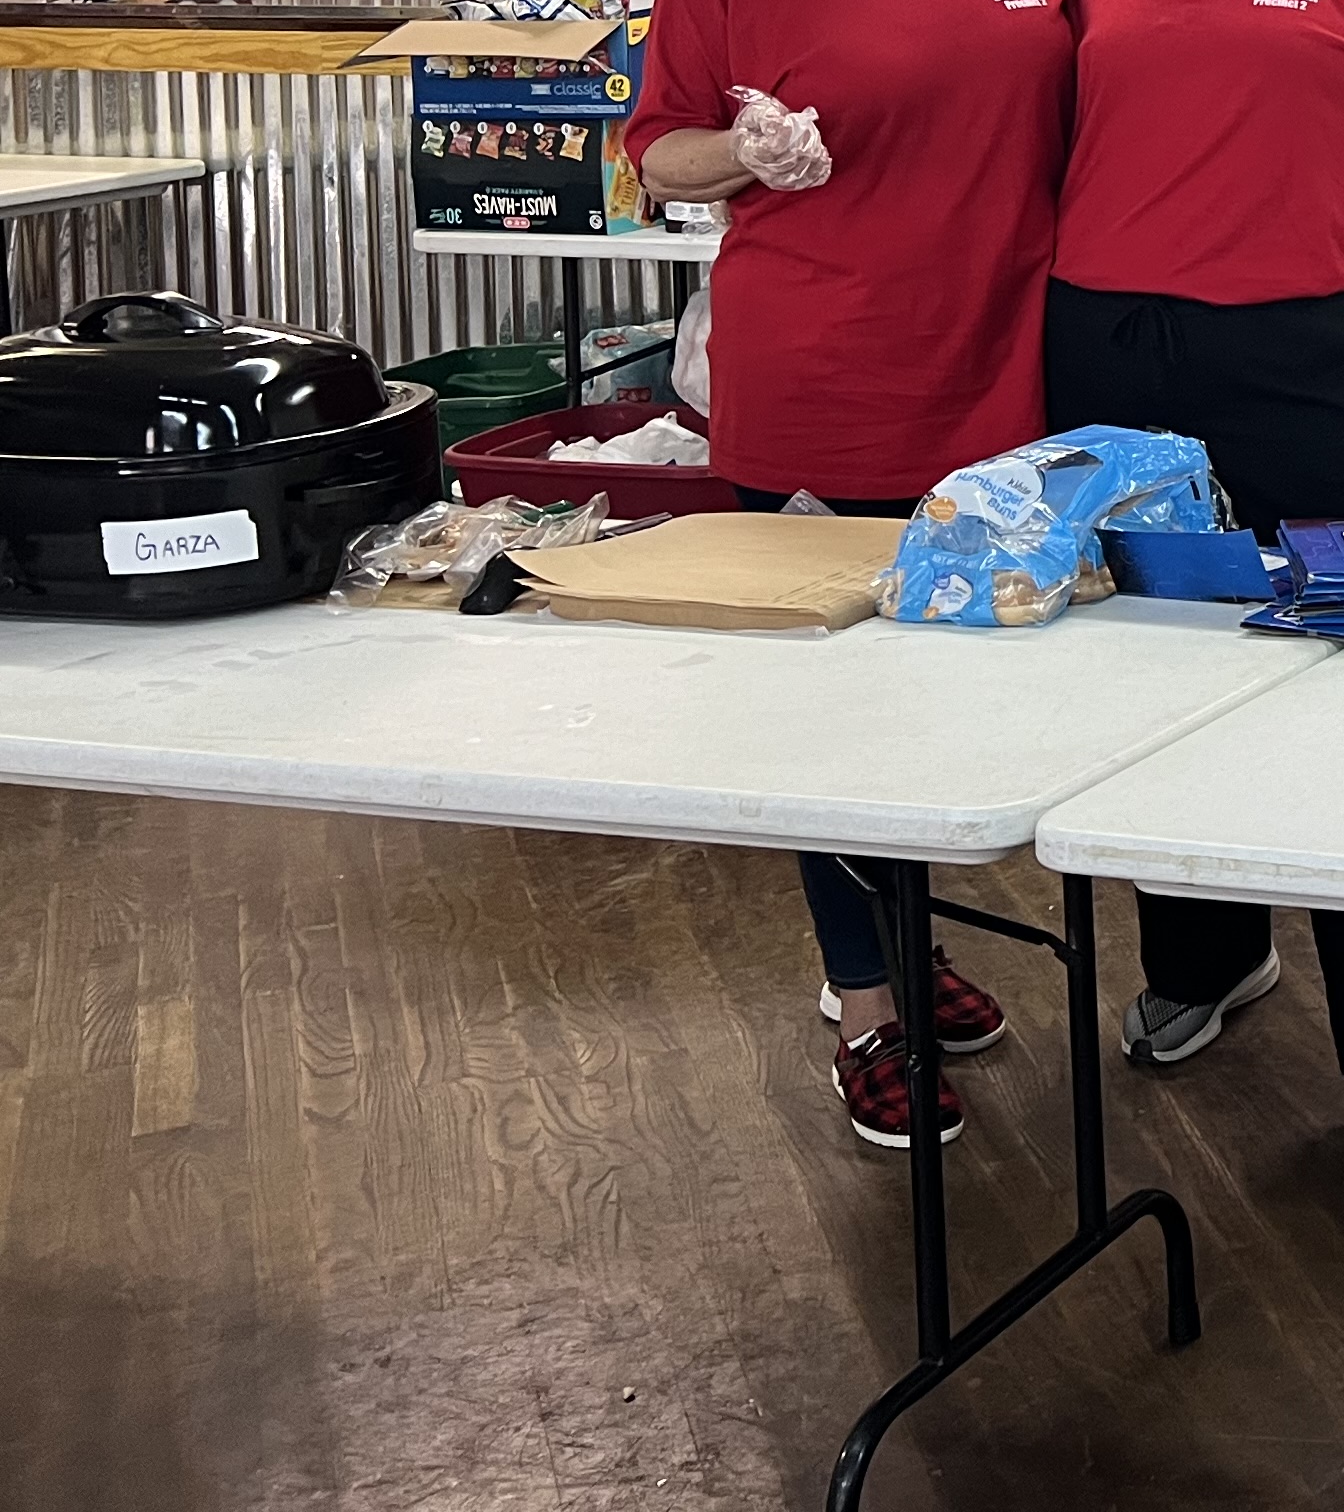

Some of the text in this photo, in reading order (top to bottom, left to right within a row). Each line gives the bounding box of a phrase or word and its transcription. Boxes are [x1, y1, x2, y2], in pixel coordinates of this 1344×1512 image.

[1299, 0, 1308, 11] 2
[553, 82, 602, 96] classic
[609, 79, 625, 93] 42
[621, 176, 636, 207] THIN
[473, 193, 557, 217] MUST-HAVES
[446, 207, 463, 224] 30
[135, 532, 220, 561] GARZA
